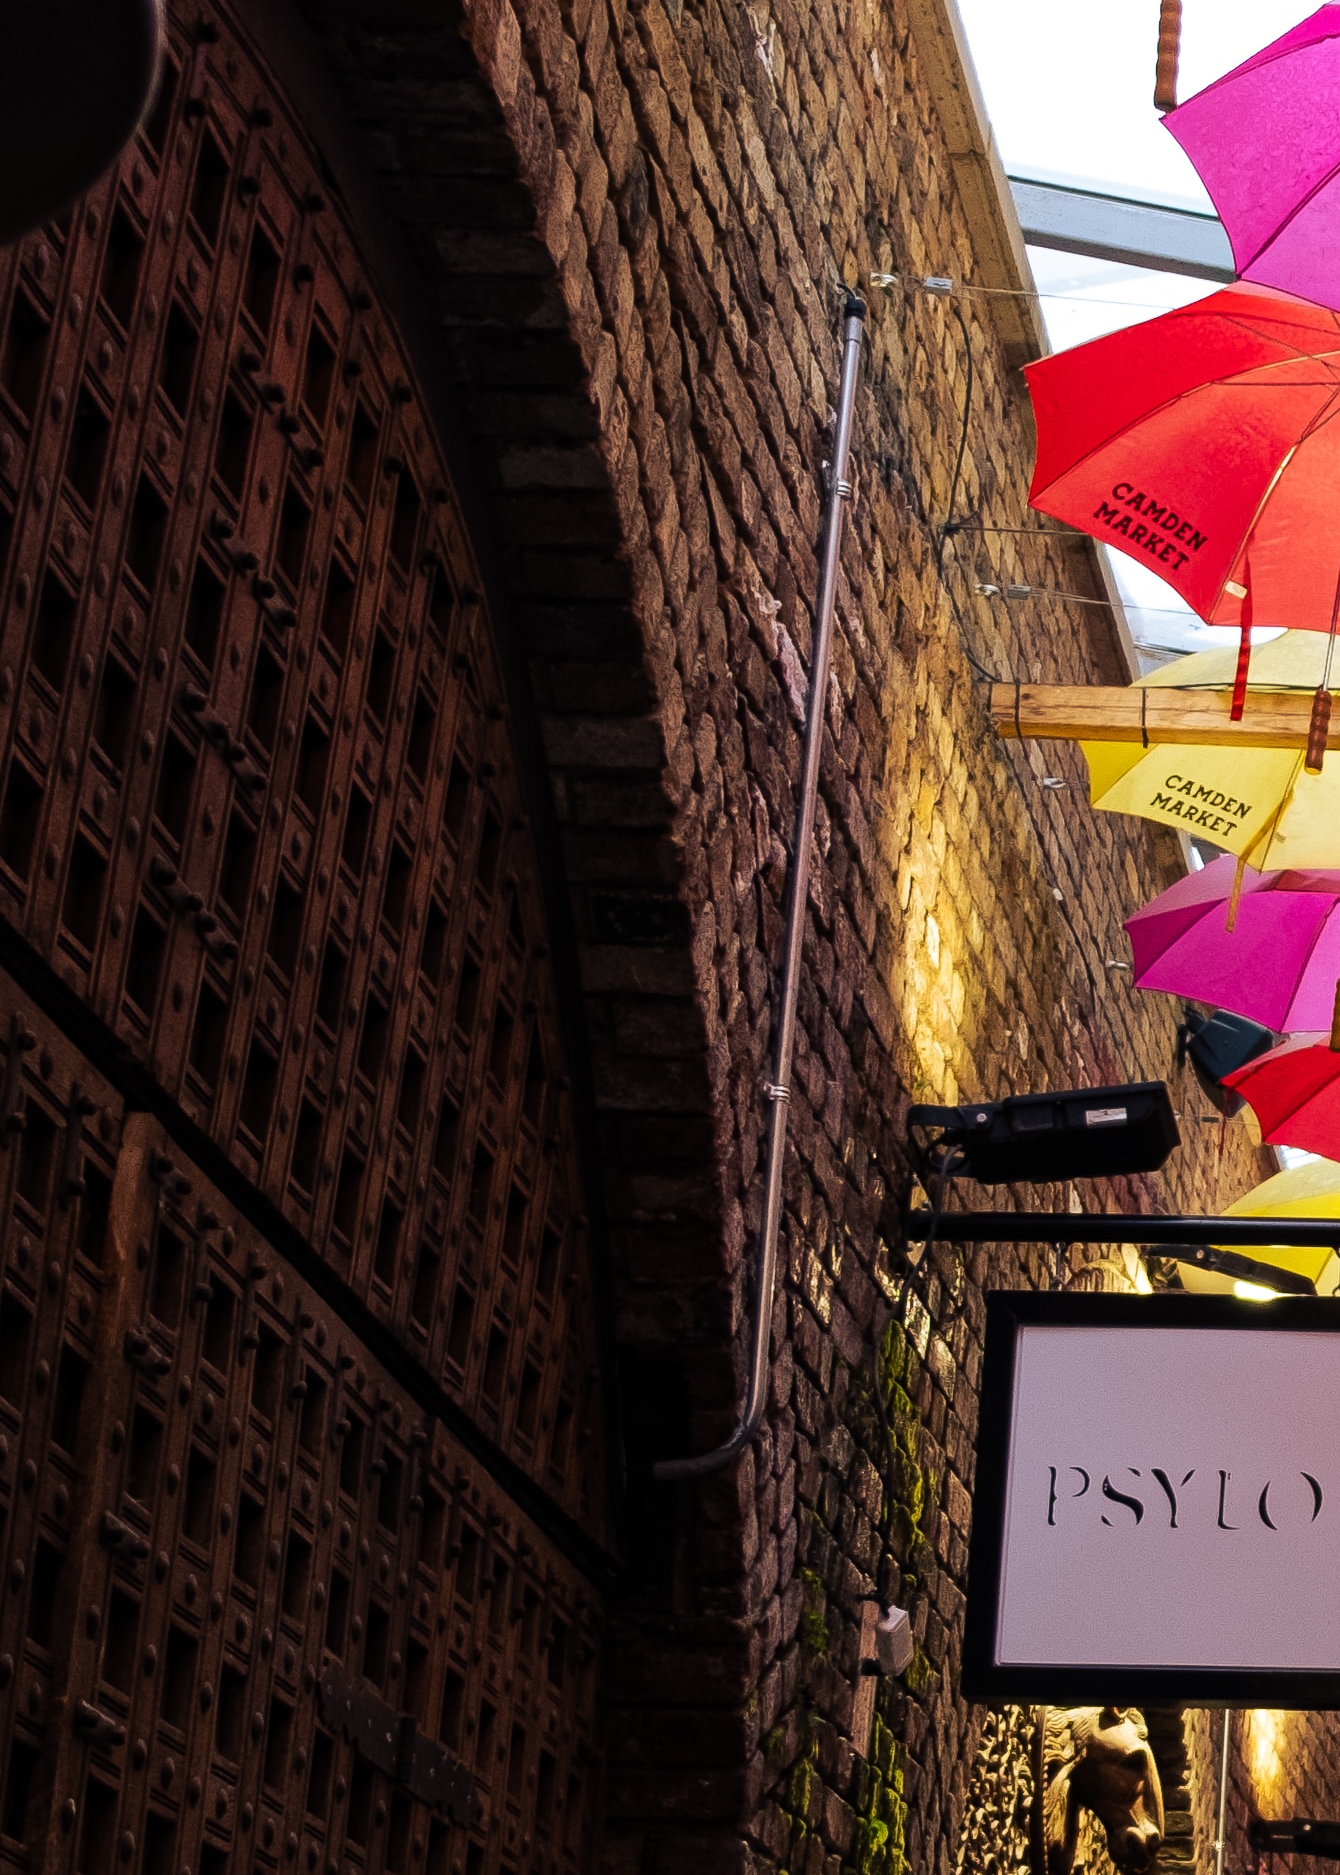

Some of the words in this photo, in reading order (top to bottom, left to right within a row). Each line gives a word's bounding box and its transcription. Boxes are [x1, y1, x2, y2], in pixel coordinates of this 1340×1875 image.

[1093, 501, 1189, 570] MARKET
[1112, 483, 1208, 551] CAMDEN
[1150, 792, 1237, 836] MARKET
[1165, 775, 1252, 818] CAMDEN
[1048, 1466, 1323, 1531] PSYLO
